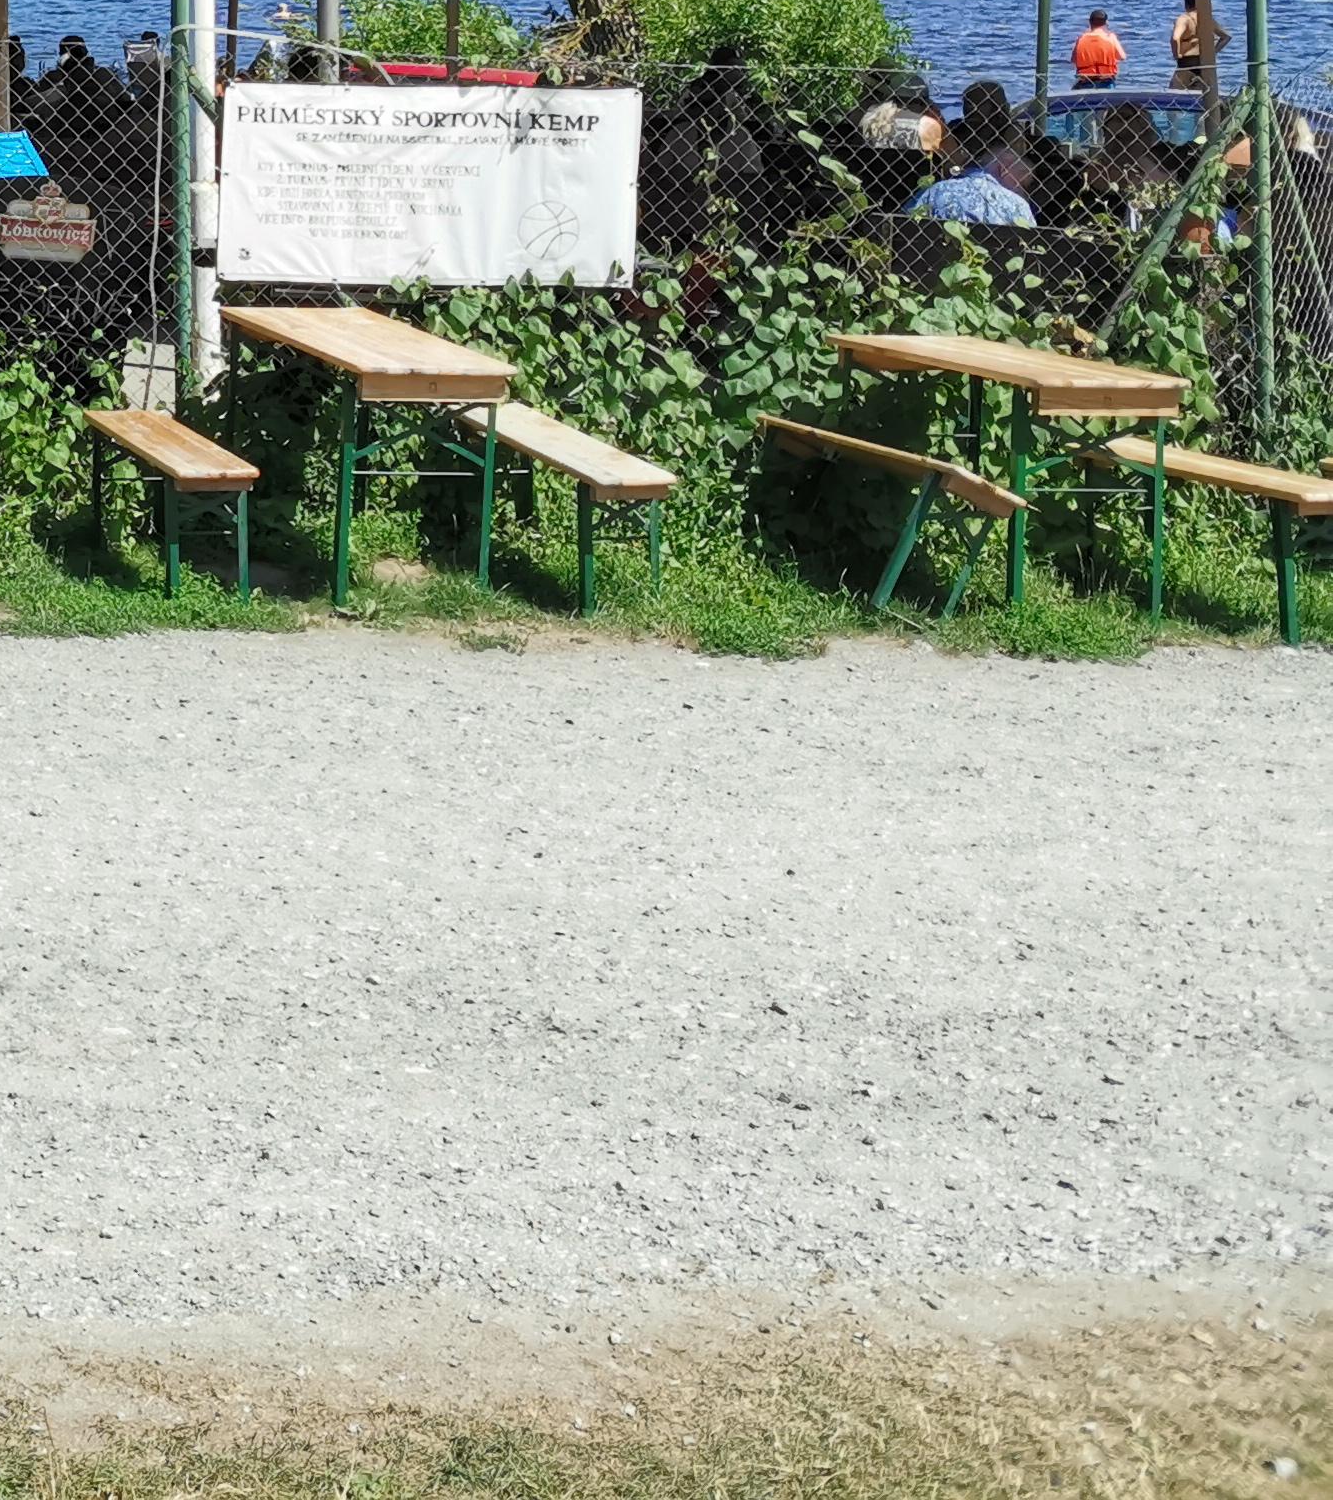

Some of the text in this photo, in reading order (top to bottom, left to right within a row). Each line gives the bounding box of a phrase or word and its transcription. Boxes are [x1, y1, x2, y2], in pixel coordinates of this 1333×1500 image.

[237, 101, 600, 132] PŘÍMĚSTSKÝ SPORTOVNÍ KEMP
